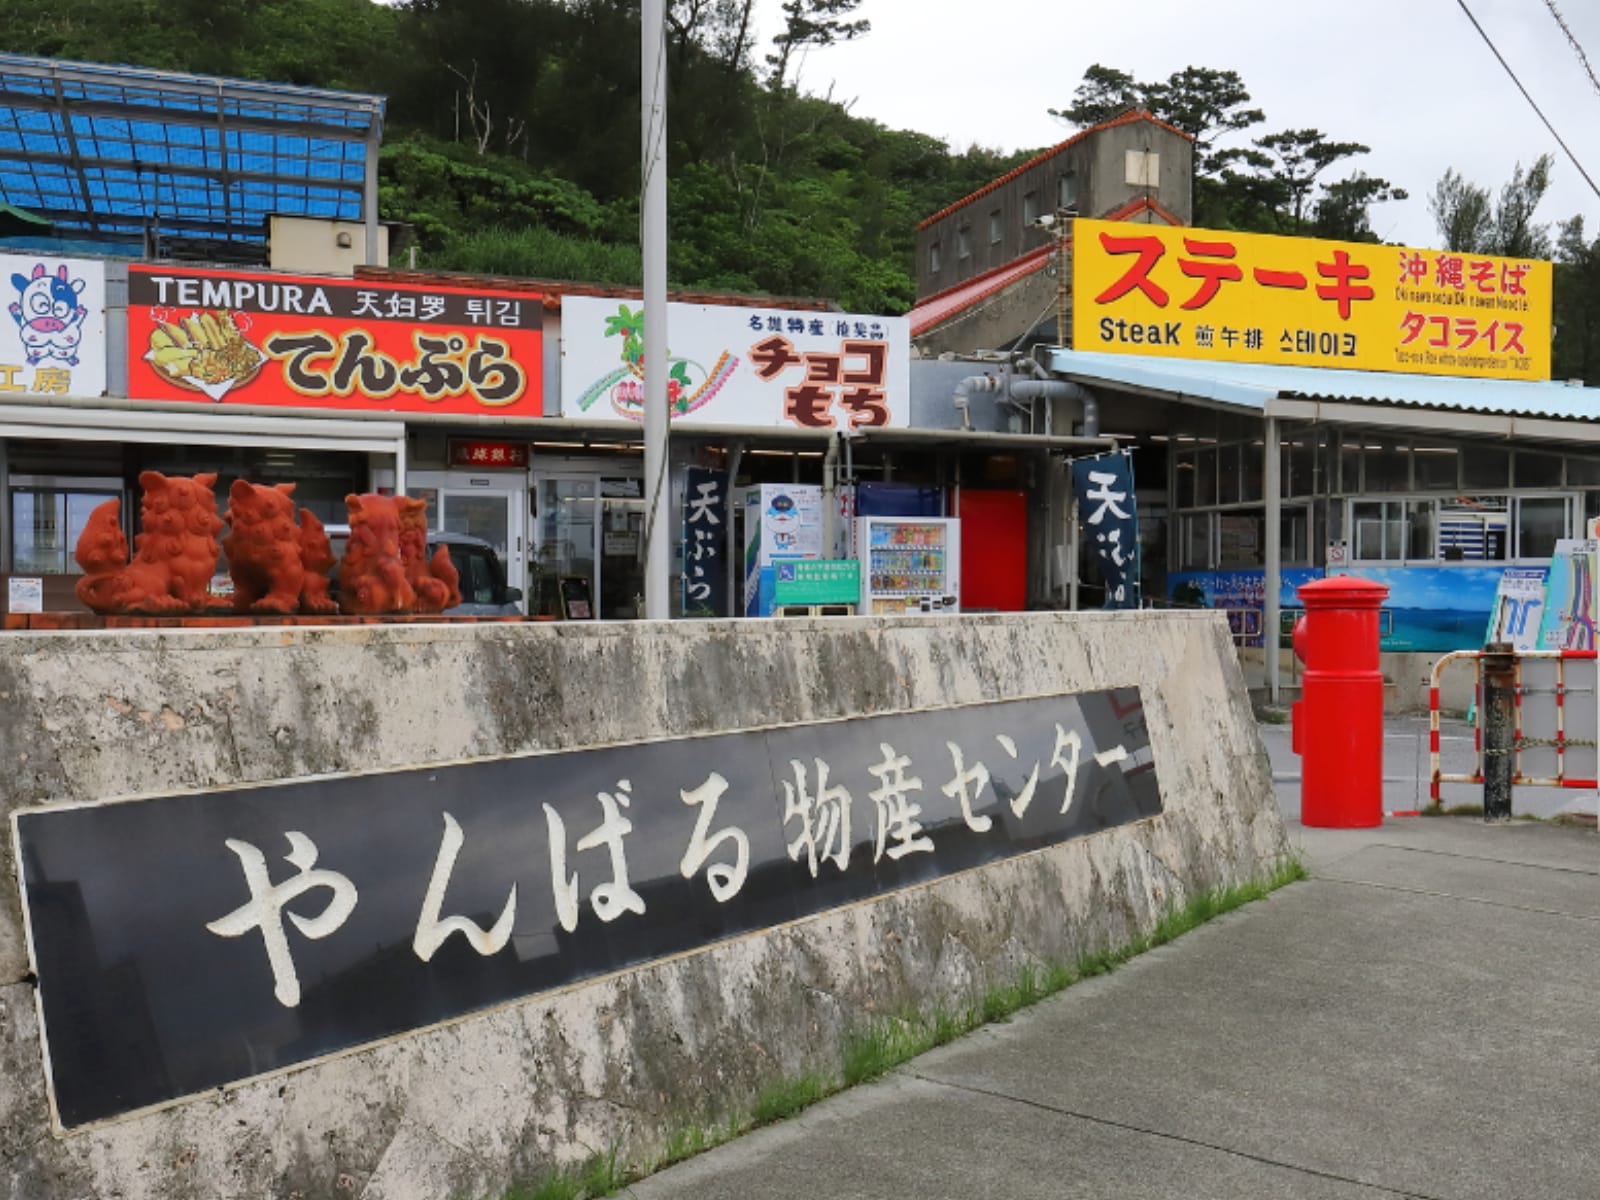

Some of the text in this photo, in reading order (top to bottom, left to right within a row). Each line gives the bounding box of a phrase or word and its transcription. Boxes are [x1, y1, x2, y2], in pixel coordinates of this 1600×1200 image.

[1095, 232, 1375, 320] ステーキ
[1398, 252, 1532, 295] 沖縄そば
[150, 276, 333, 316] TEMPURA
[464, 299, 520, 326] 튀김
[1279, 329, 1357, 357] 스테이크
[1399, 311, 1525, 355] タコライス
[0, 365, 71, 394] 工房
[266, 331, 524, 404] てんぷら
[749, 335, 888, 387] チョコ
[785, 386, 890, 429] もち
[206, 722, 1128, 1008] やんばる物産センター
